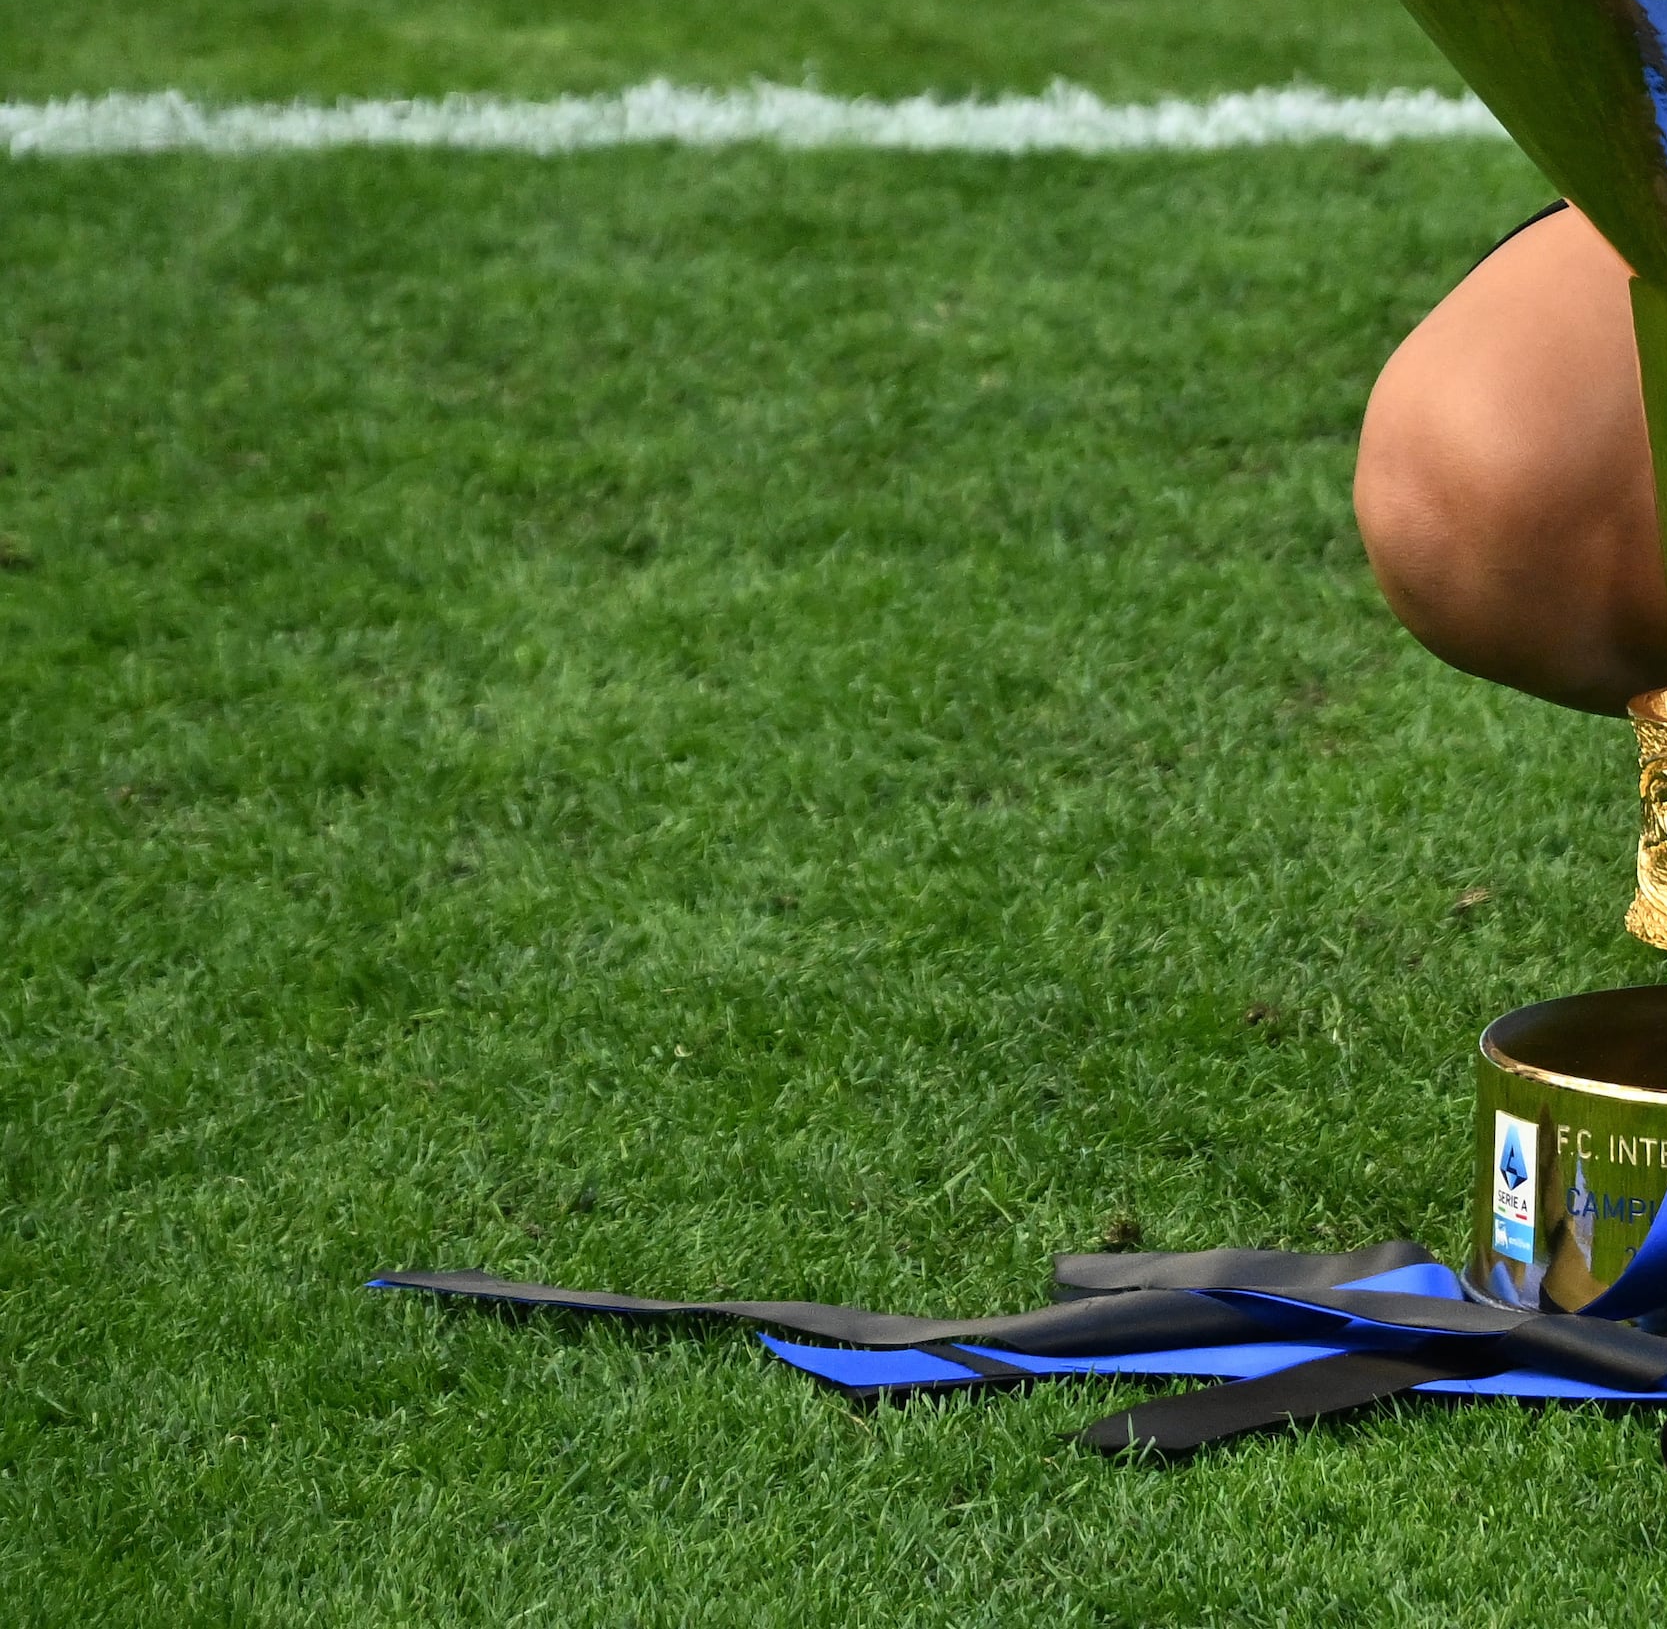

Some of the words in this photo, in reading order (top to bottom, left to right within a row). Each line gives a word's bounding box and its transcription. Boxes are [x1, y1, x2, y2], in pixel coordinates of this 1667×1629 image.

[1556, 1124, 1600, 1161] F.C.
[1498, 1189, 1519, 1210] SERIE
[1520, 1198, 1528, 1213] A
